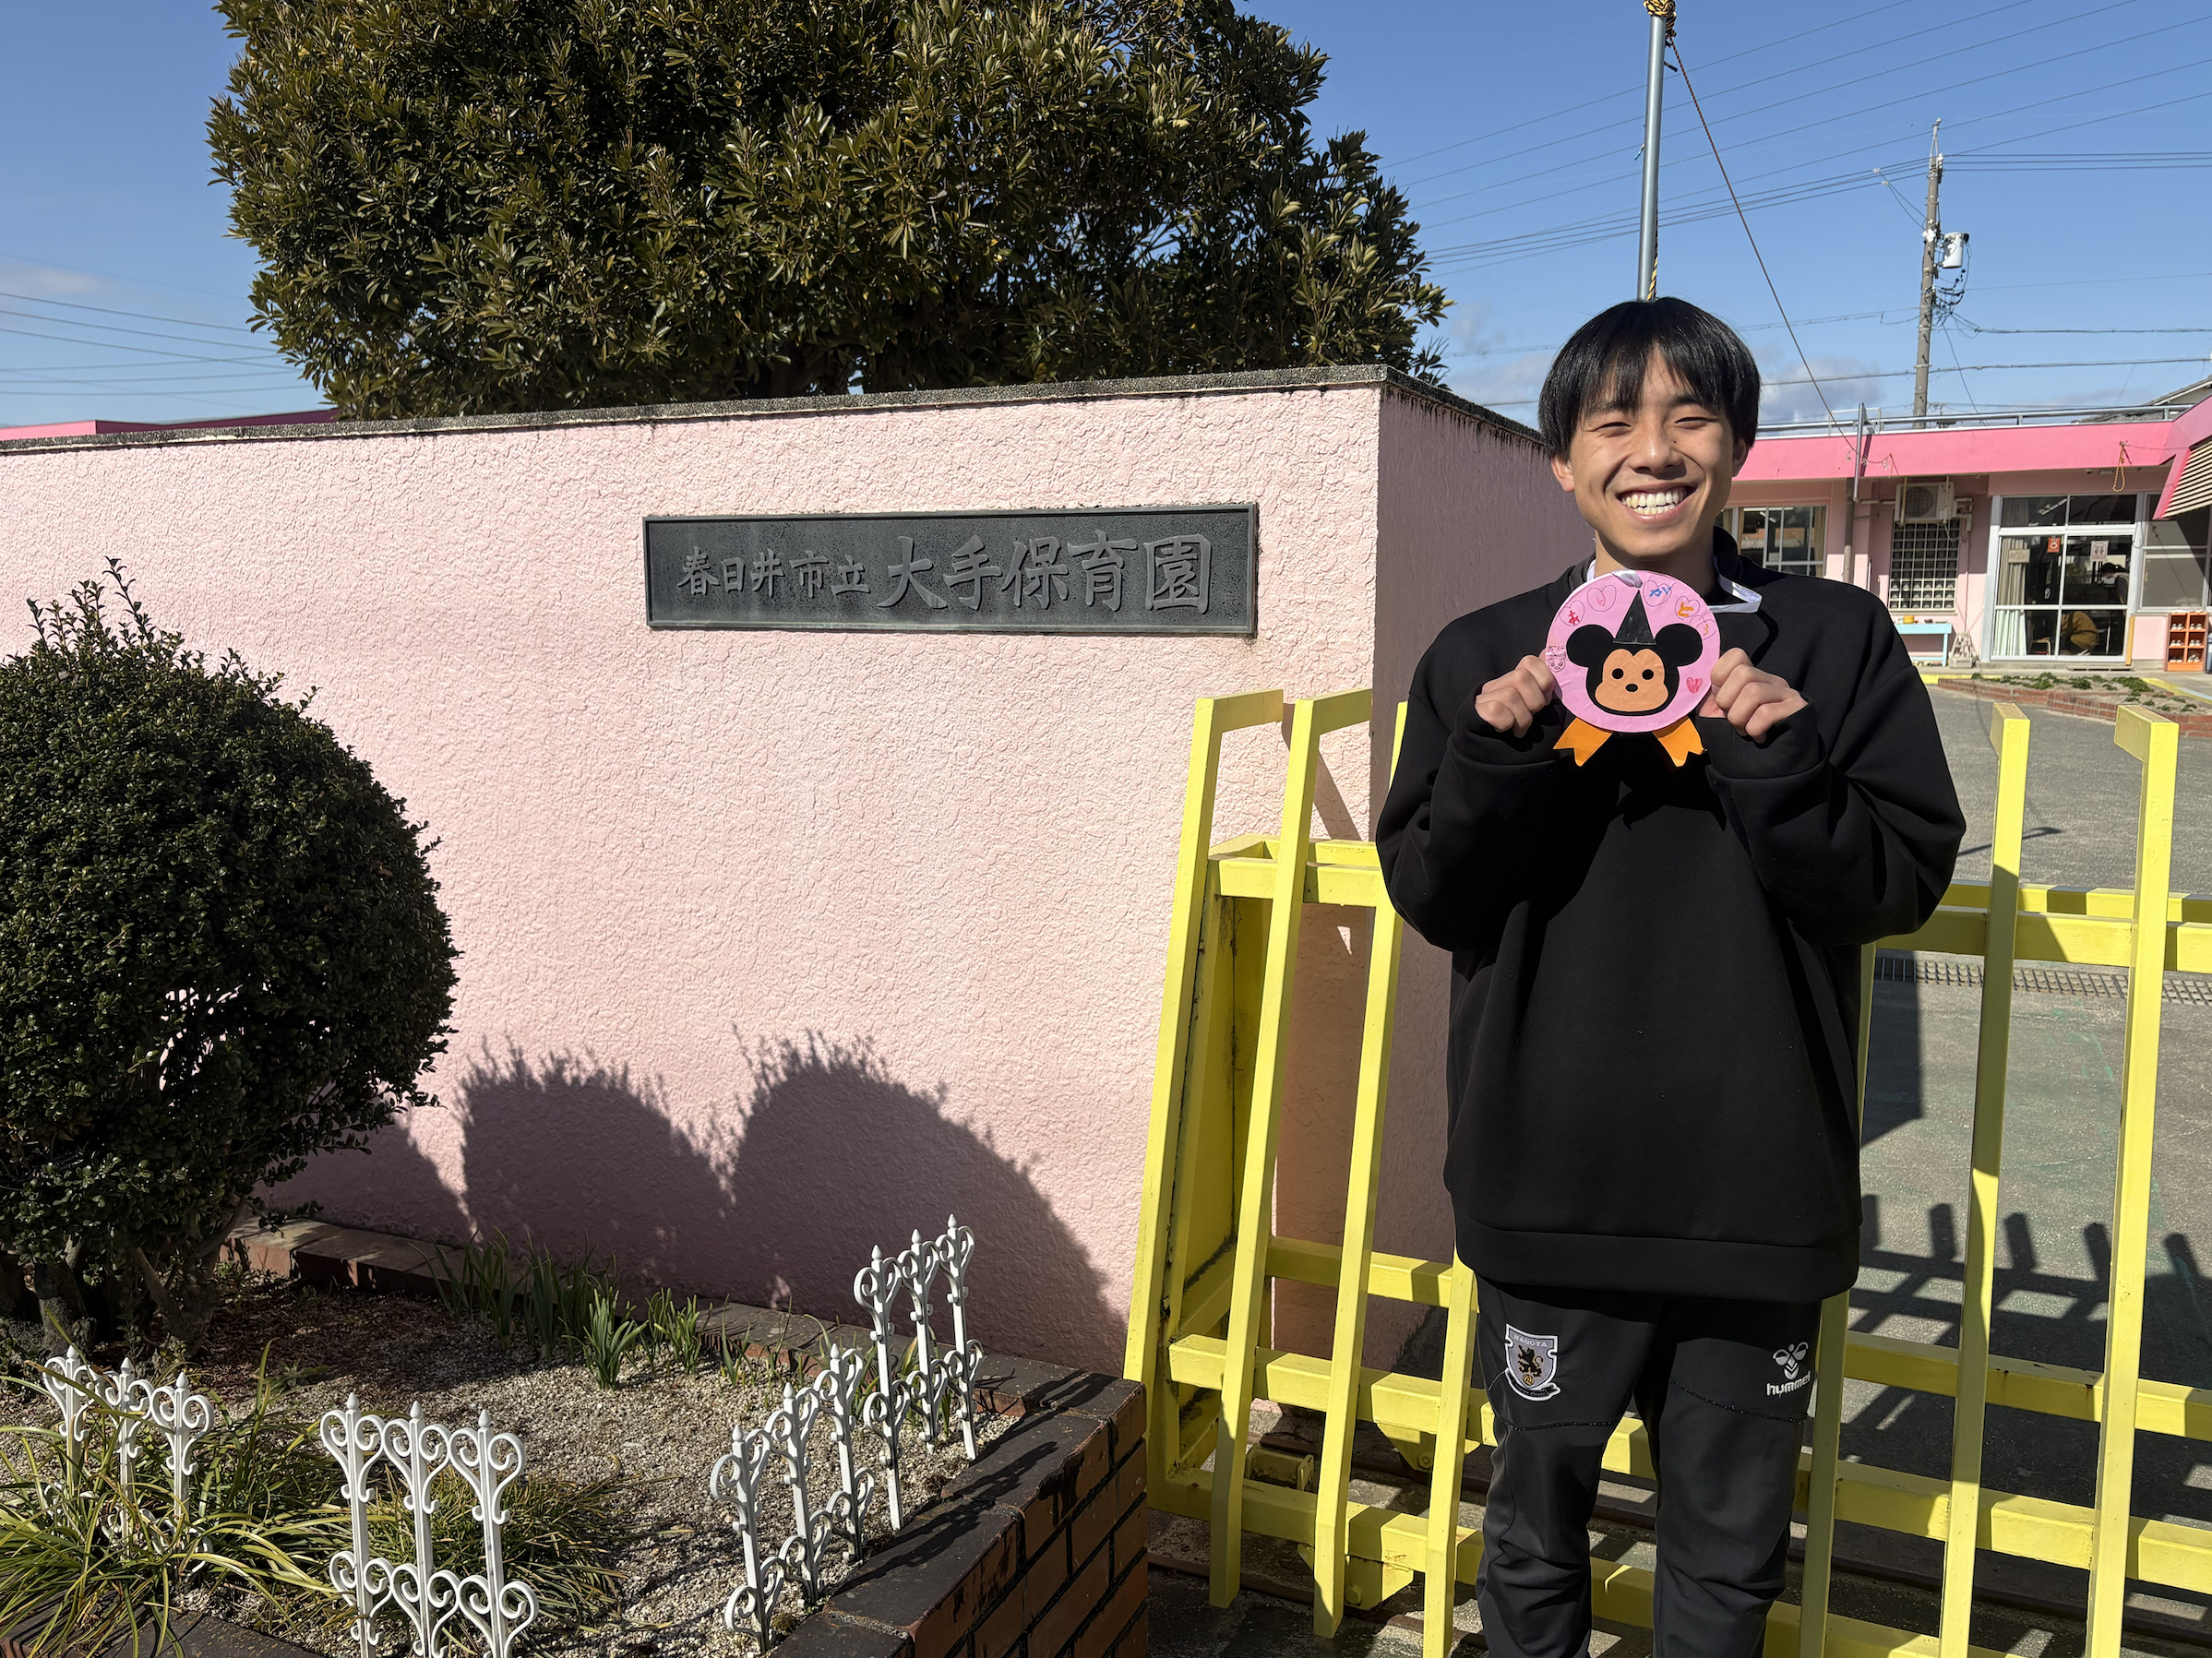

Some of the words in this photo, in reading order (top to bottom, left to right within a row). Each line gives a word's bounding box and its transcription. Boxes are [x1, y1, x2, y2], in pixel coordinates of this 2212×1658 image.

[676, 546, 871, 599] 春日井市立
[877, 529, 1212, 614] 大手保育園
[1513, 1334, 1548, 1347] NAGOYA
[1766, 1370, 1811, 1399] hummel
